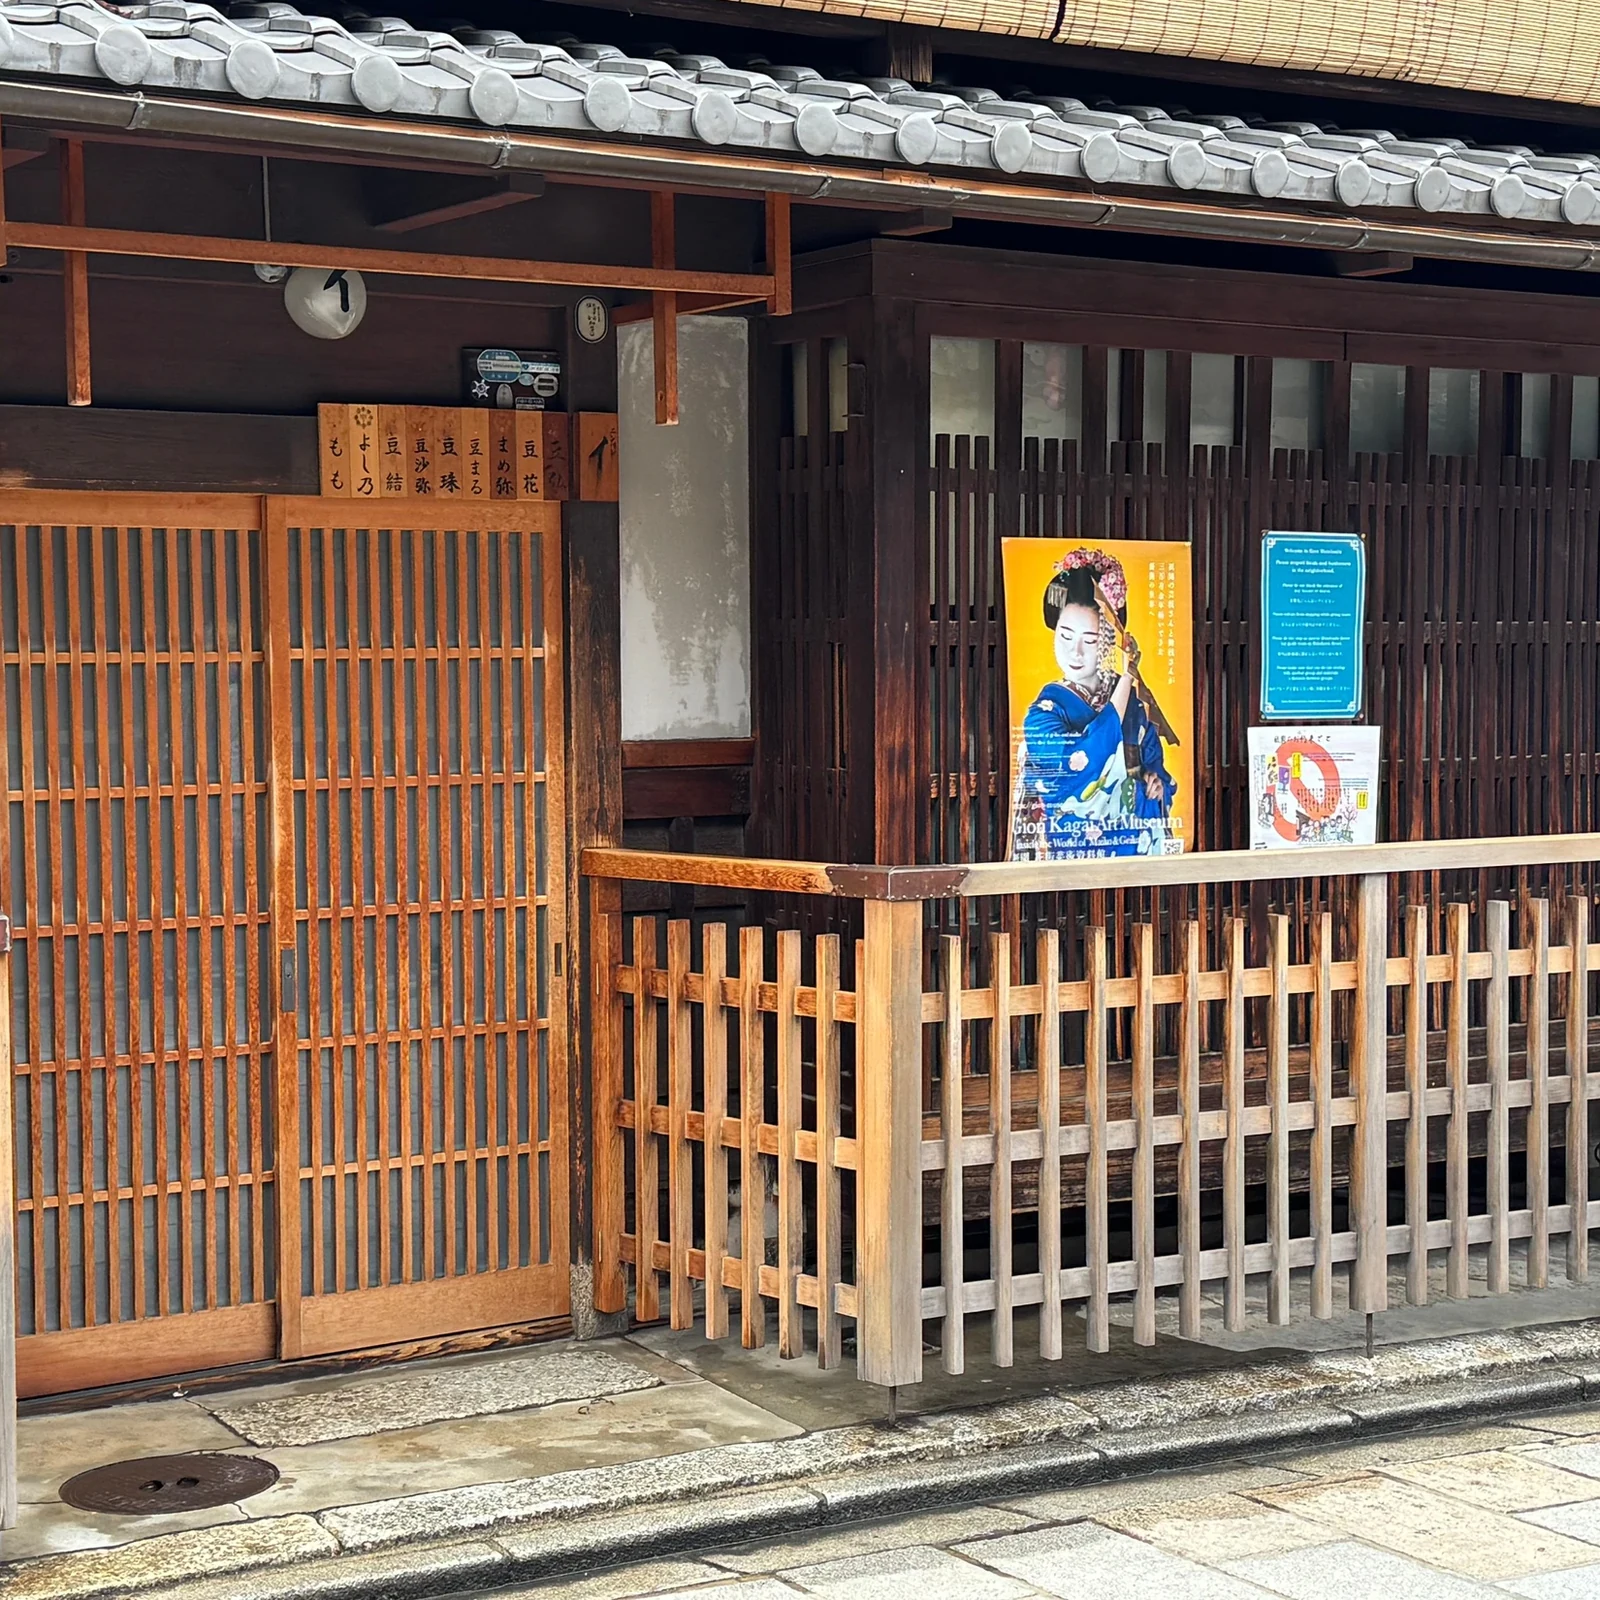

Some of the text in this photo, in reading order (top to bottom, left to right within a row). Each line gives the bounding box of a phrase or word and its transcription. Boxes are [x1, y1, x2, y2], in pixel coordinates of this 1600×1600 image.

[329, 437, 344, 490] もも
[356, 433, 374, 496] よし乃
[384, 437, 404, 492] 豆結
[469, 438, 483, 495] 豆まる
[496, 436, 514, 495] まめ弥
[522, 440, 539, 494] 豆花
[1013, 813, 1183, 837] Gion Kagai Art Museum
[1053, 837, 1077, 848] World
[1078, 838, 1086, 847] of
